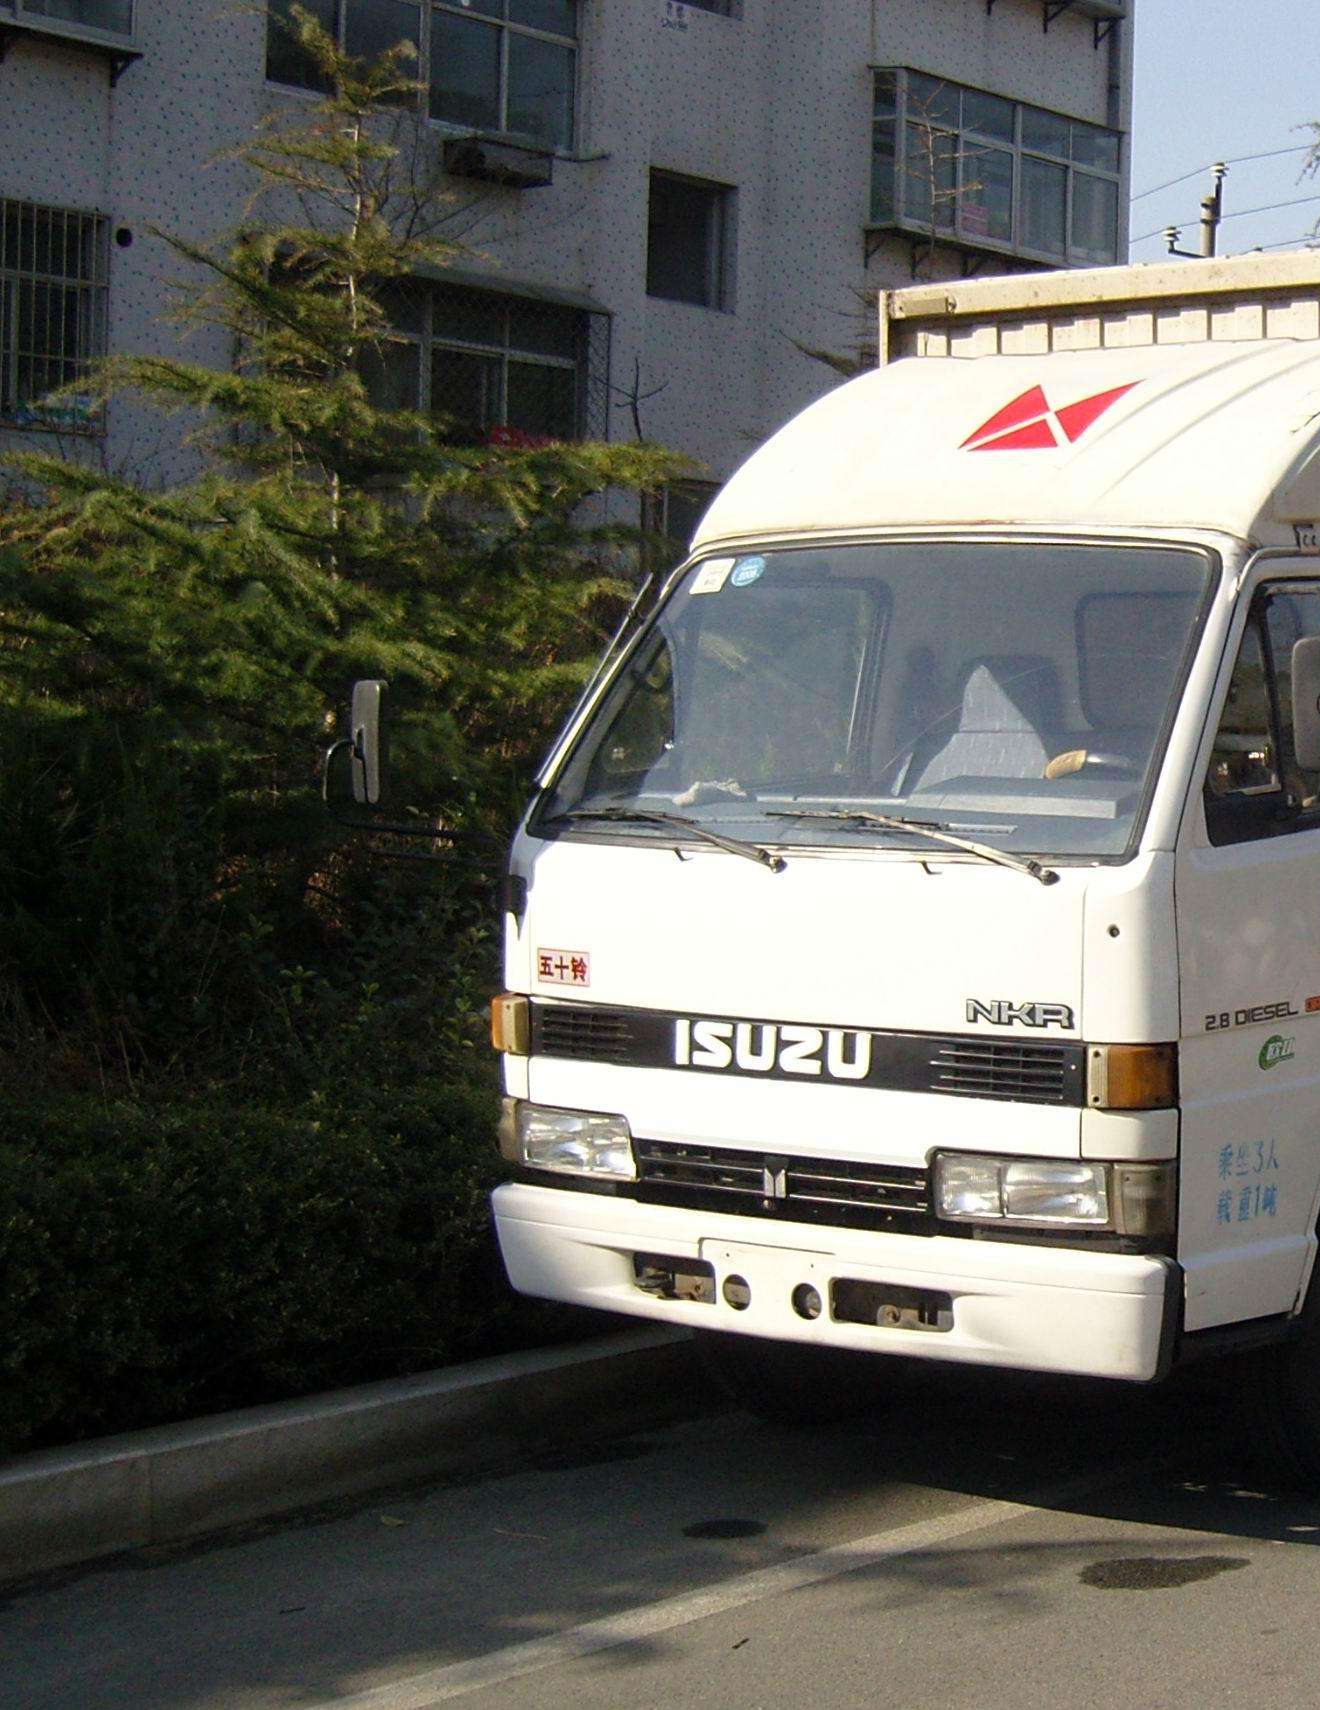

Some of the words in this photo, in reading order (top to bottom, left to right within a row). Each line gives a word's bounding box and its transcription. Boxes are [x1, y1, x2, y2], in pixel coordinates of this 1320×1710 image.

[539, 955, 588, 982] 五十铃
[966, 998, 1075, 1030] NKR
[1204, 1013, 1231, 1031] 2.8
[1234, 1001, 1298, 1025] DIESEL
[674, 1018, 873, 1080] ISUZU
